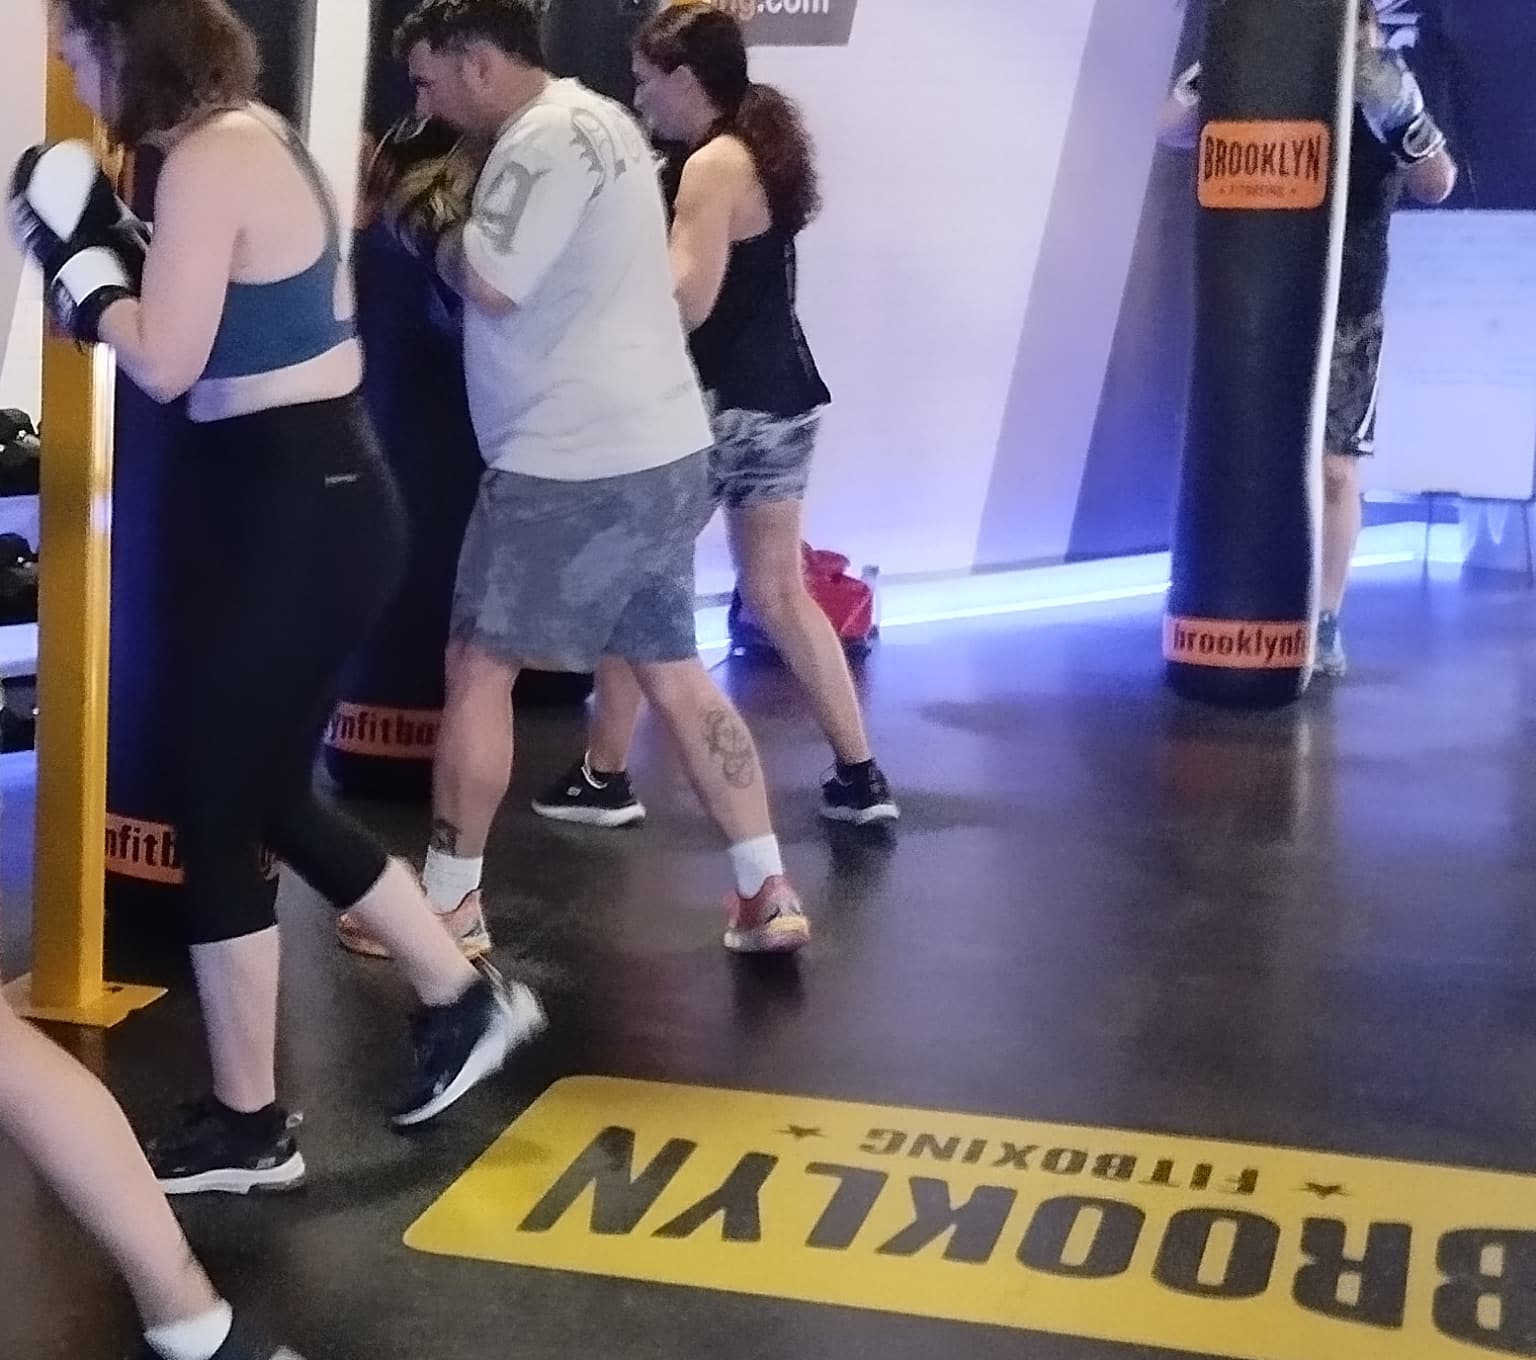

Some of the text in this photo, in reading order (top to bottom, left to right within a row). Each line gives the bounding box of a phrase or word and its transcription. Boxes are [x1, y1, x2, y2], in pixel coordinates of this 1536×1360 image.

[1204, 136, 1321, 182] BROOKLYN
[860, 1128, 1260, 1195] FITBOXING
[514, 1125, 1536, 1358] BROOKLYN
